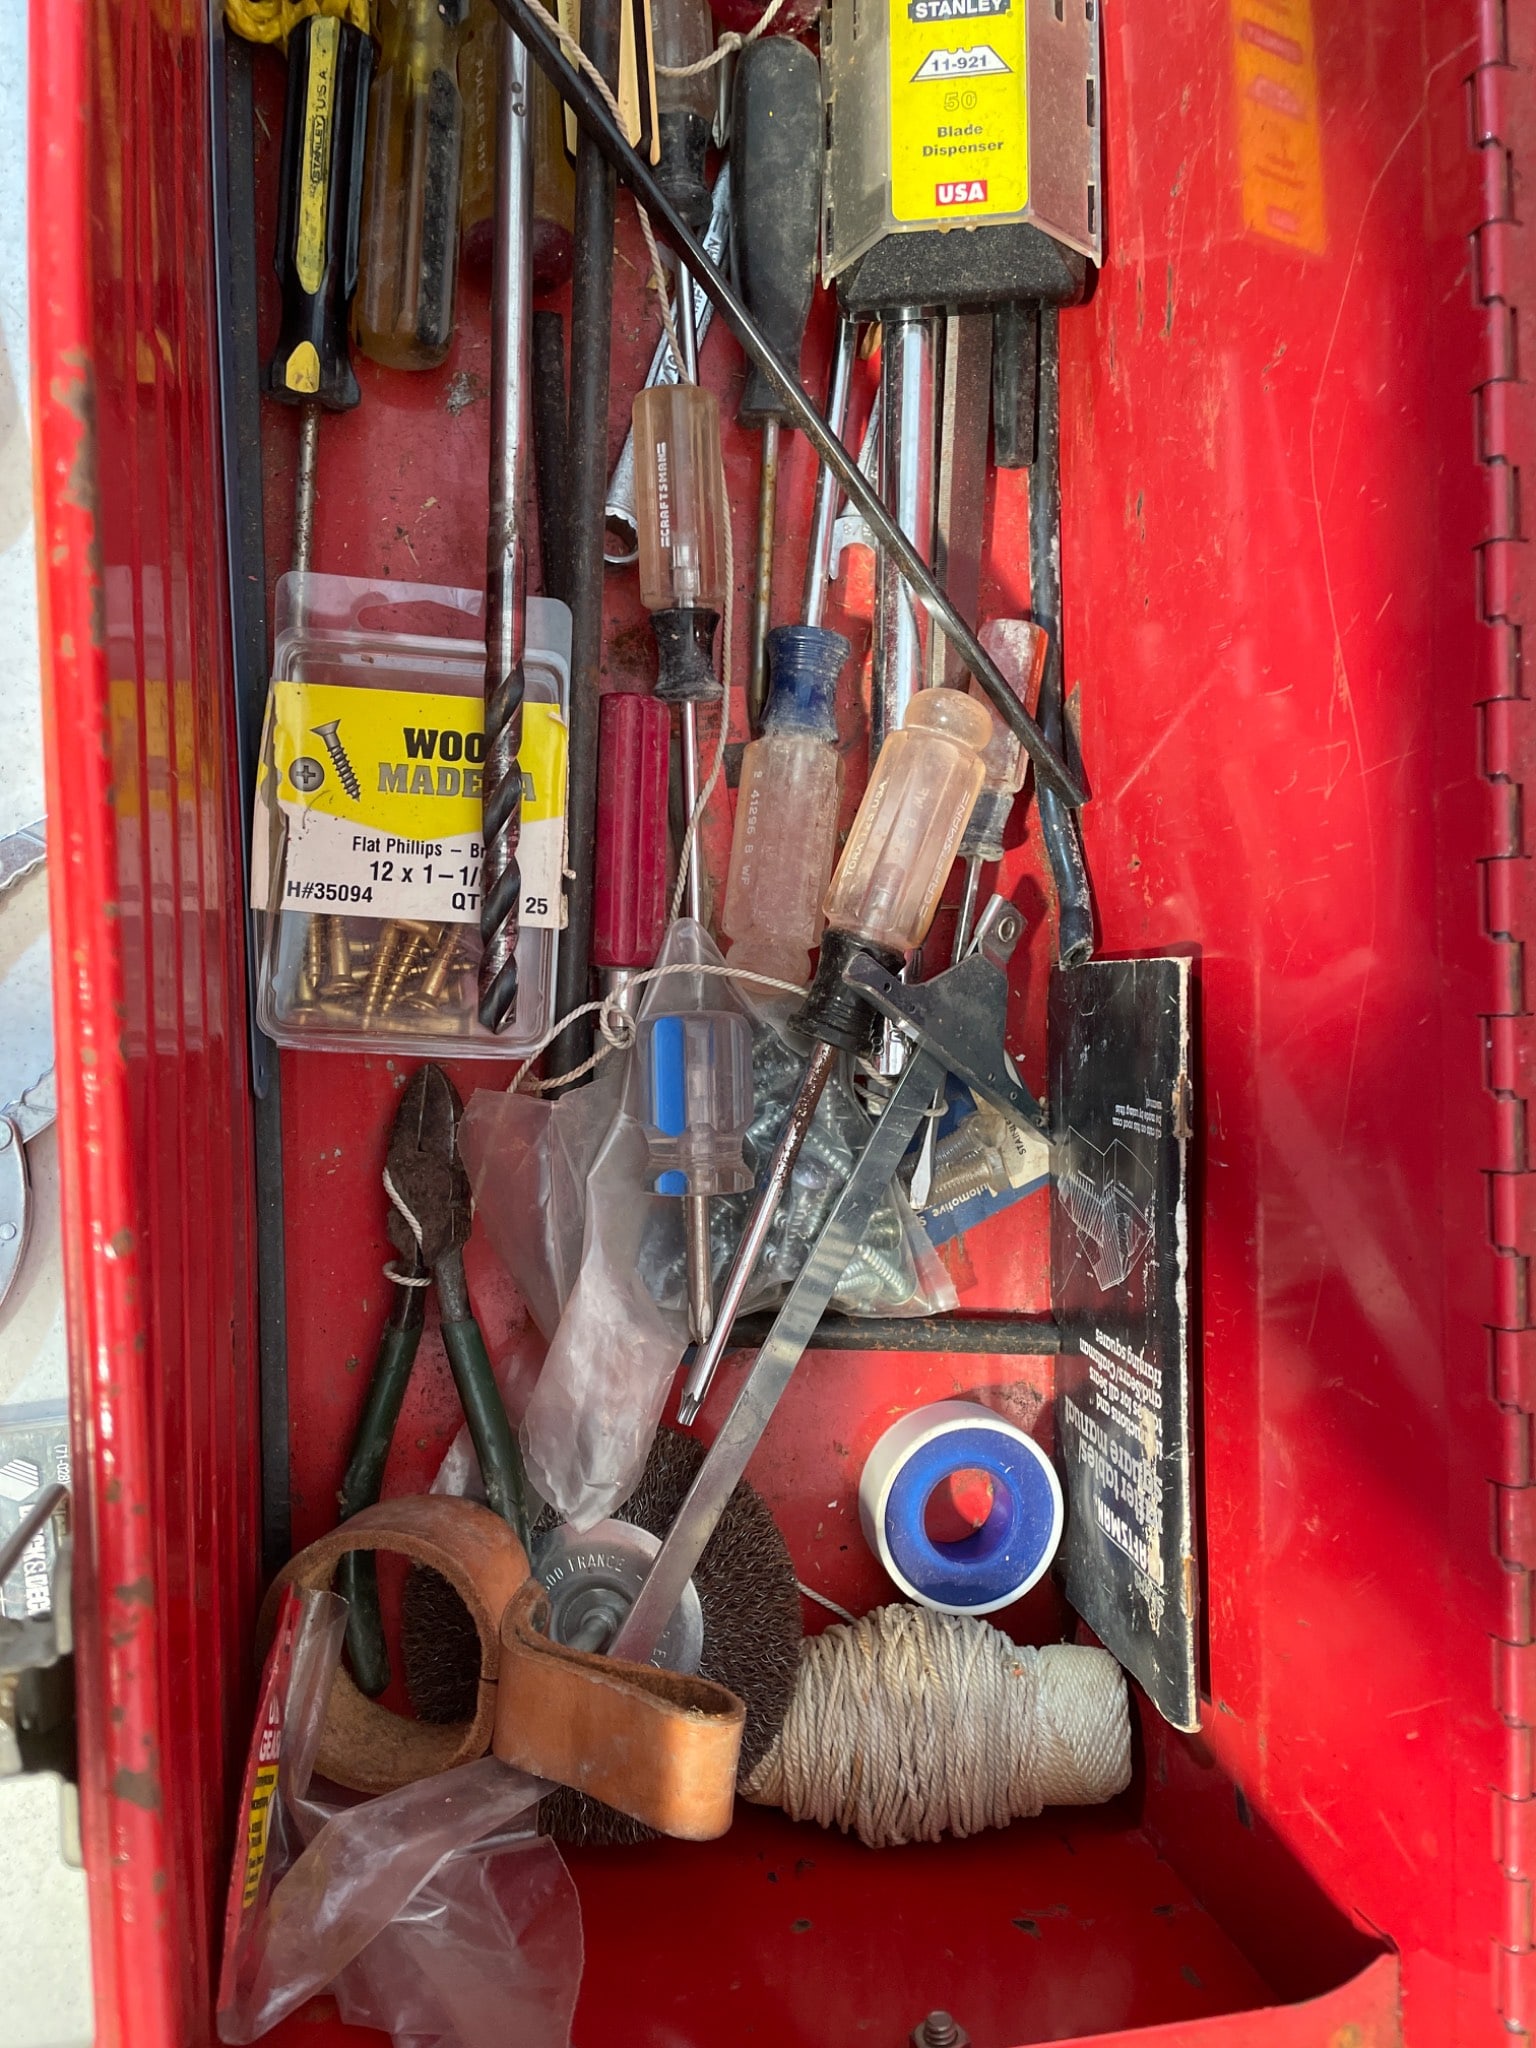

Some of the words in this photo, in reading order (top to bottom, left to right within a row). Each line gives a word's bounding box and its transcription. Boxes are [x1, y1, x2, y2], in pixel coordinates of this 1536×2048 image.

[915, 0, 1003, 18] STANLEY
[931, 55, 989, 72] 11-921
[943, 90, 977, 112] 50
[936, 123, 984, 138] Blade
[312, 118, 324, 180] STANLEY
[922, 138, 1005, 158] Dispenser
[937, 182, 985, 204] USA
[657, 452, 671, 538] CRAFTSMAN
[403, 727, 487, 763] WOO
[352, 836, 381, 854] Flat
[386, 838, 443, 858] Phillips
[843, 842, 865, 878] TORX
[923, 805, 969, 905] CRAFTSMAN
[369, 860, 394, 883] 12
[401, 867, 414, 884] x
[286, 880, 374, 904] H#35094
[451, 892, 482, 911] QT
[525, 896, 549, 916] 25
[1095, 1328, 1127, 1360] squares
[1089, 1365, 1108, 1397] Sears
[1126, 1345, 1163, 1389] framing
[1095, 1392, 1111, 1416] and
[1108, 1381, 1120, 1402] all
[1120, 1390, 1132, 1415] for
[1142, 1386, 1163, 1410] and
[1064, 1394, 1108, 1457] manual
[1078, 1435, 1120, 1501] tables/
[1109, 1439, 1164, 1503] square
